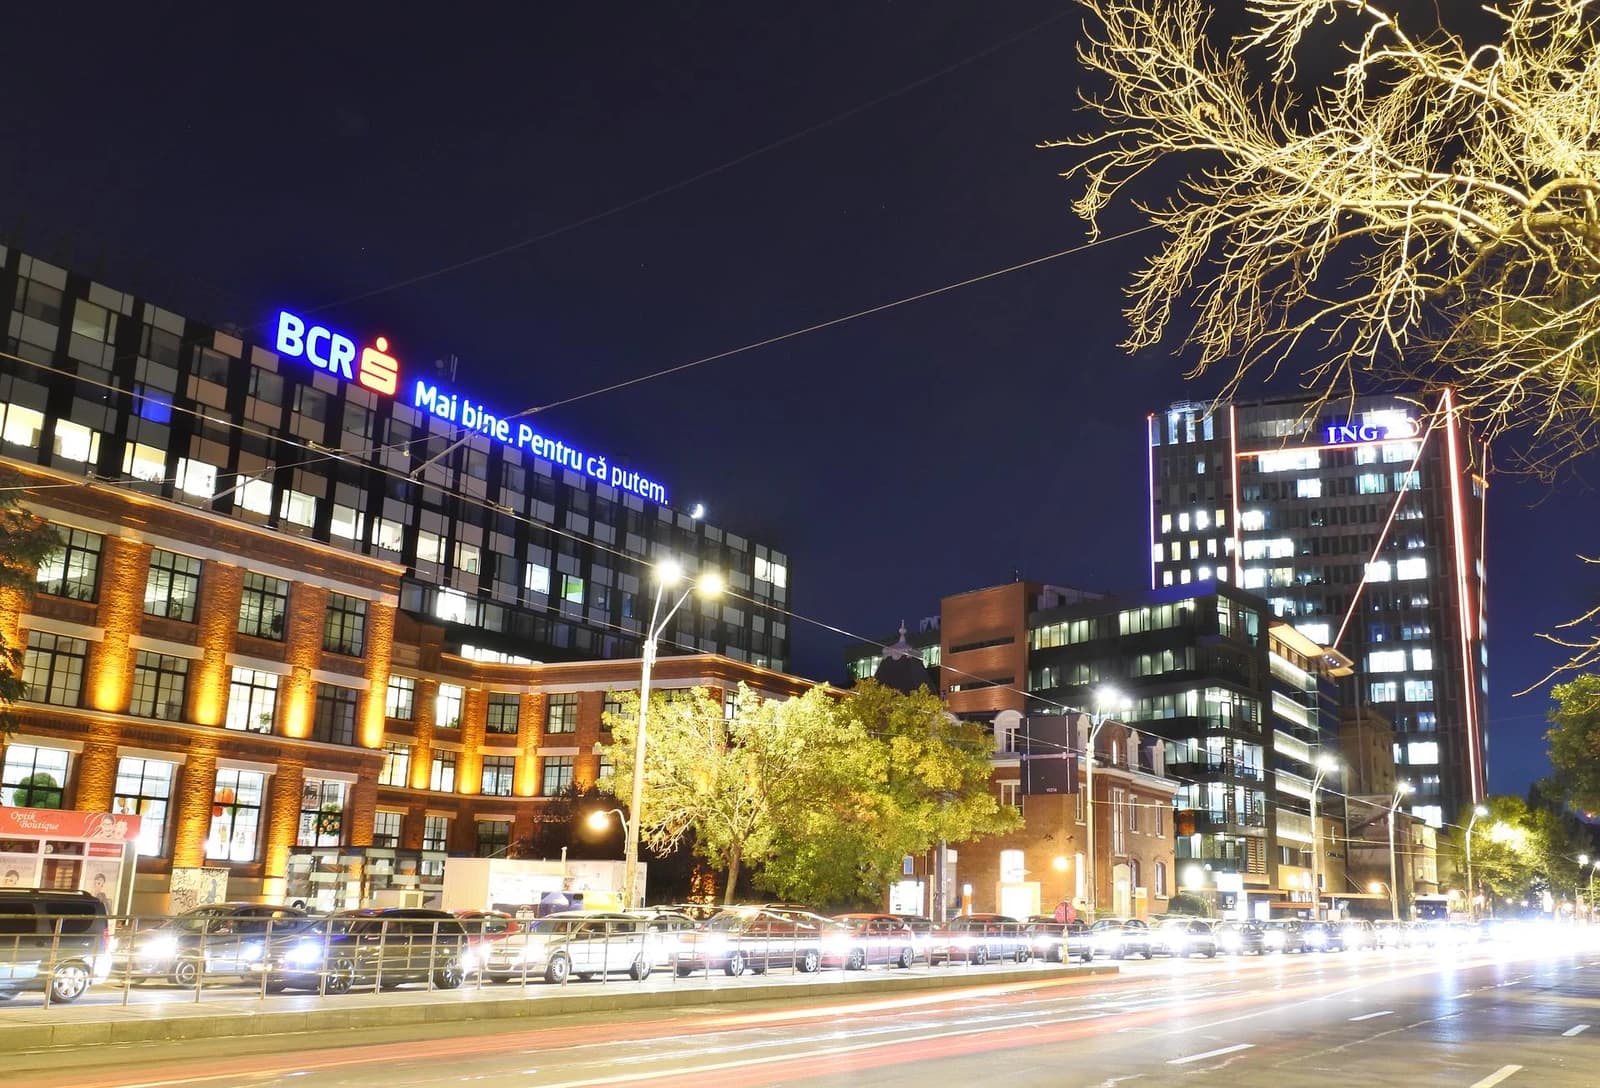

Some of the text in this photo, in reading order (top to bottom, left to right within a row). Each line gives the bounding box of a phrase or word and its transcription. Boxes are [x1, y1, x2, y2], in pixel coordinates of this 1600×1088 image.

[277, 311, 356, 379] BCR
[415, 380, 668, 505] Mai bine. Pentru că putem.
[1328, 424, 1378, 444] ING
[10, 811, 37, 823] Optik
[20, 820, 60, 832] Boutique
